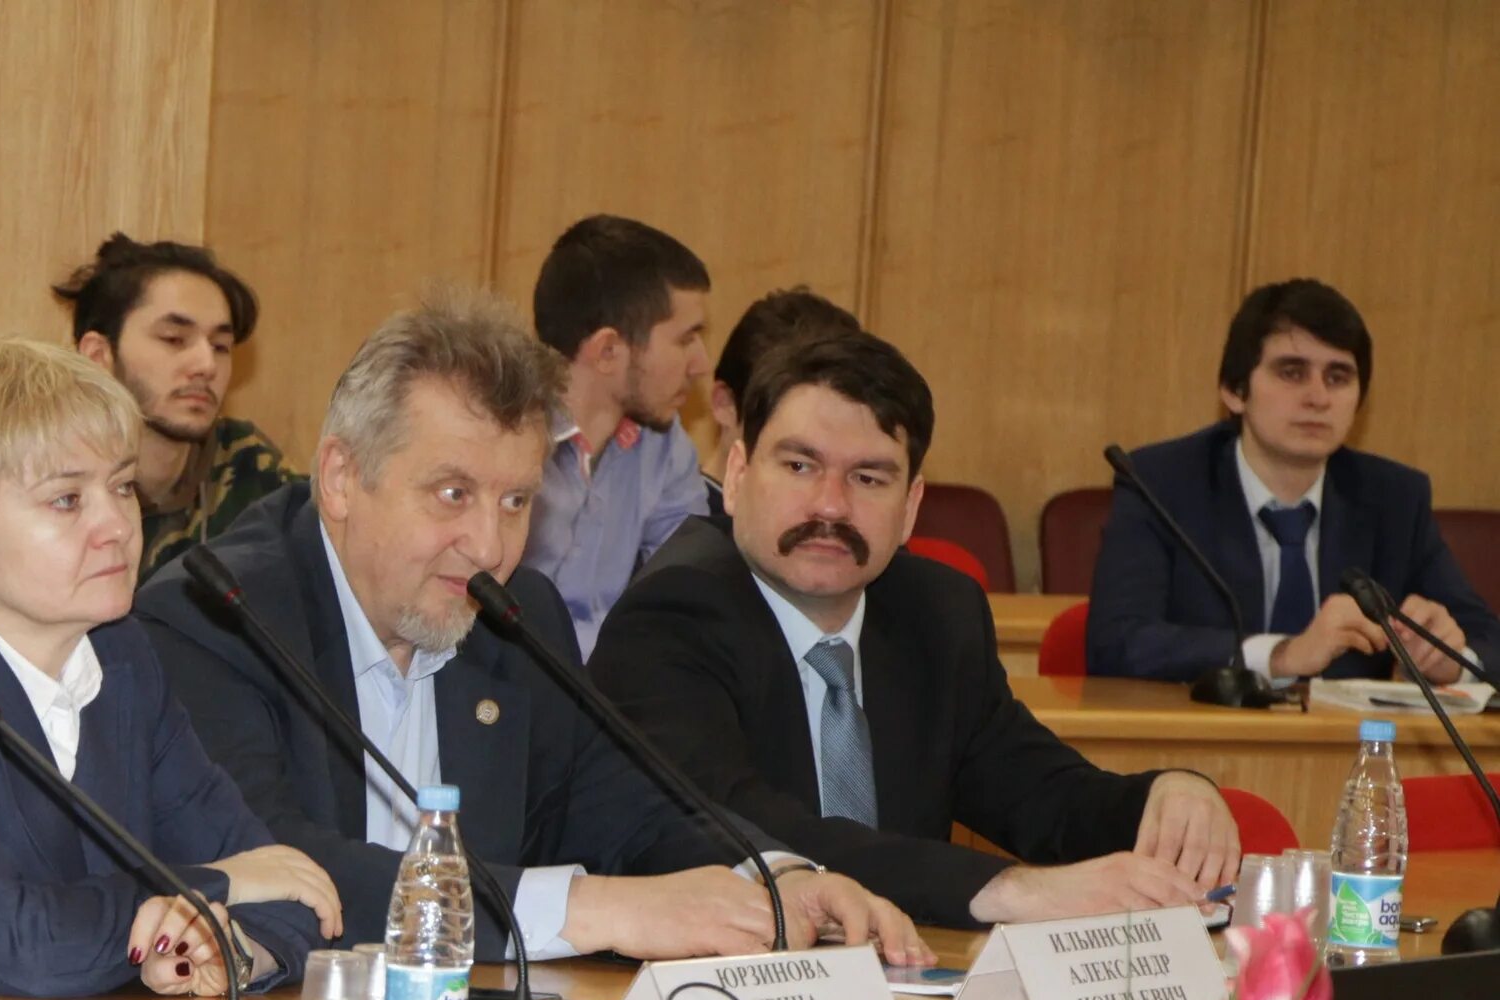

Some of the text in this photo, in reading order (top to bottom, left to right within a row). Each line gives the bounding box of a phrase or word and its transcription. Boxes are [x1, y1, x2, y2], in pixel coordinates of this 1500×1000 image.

[1049, 918, 1162, 953] ИЛЬИНСКИЙ
[714, 958, 831, 990] ЮРЗИНОВА
[1069, 954, 1171, 985] АЛЕКСАНДР
